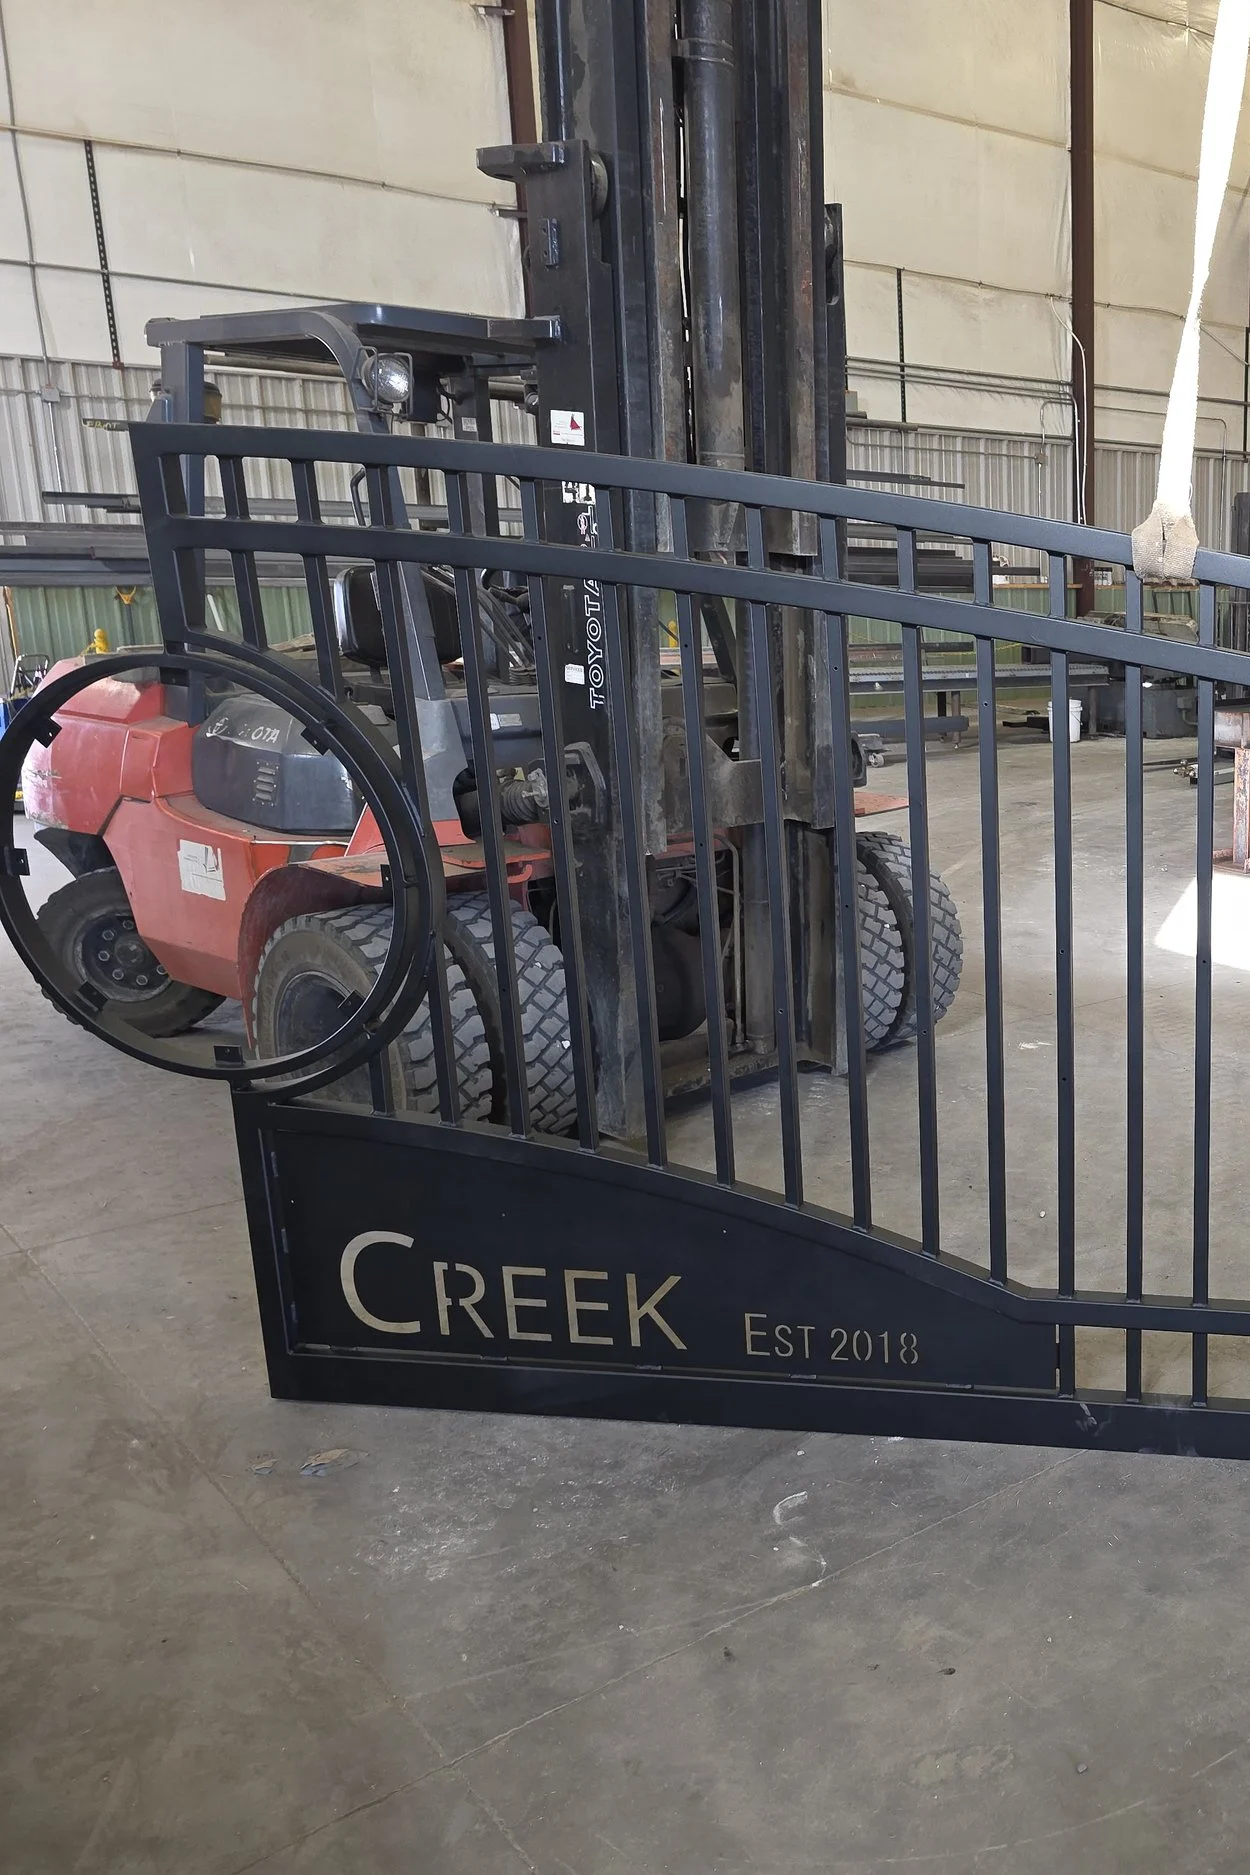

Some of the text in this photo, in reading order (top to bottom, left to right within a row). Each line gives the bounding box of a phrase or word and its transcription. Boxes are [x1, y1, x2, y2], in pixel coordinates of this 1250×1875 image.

[584, 579, 605, 709] TOYOTA
[340, 1230, 688, 1350] CREEK
[744, 1312, 919, 1365] EST 2018
